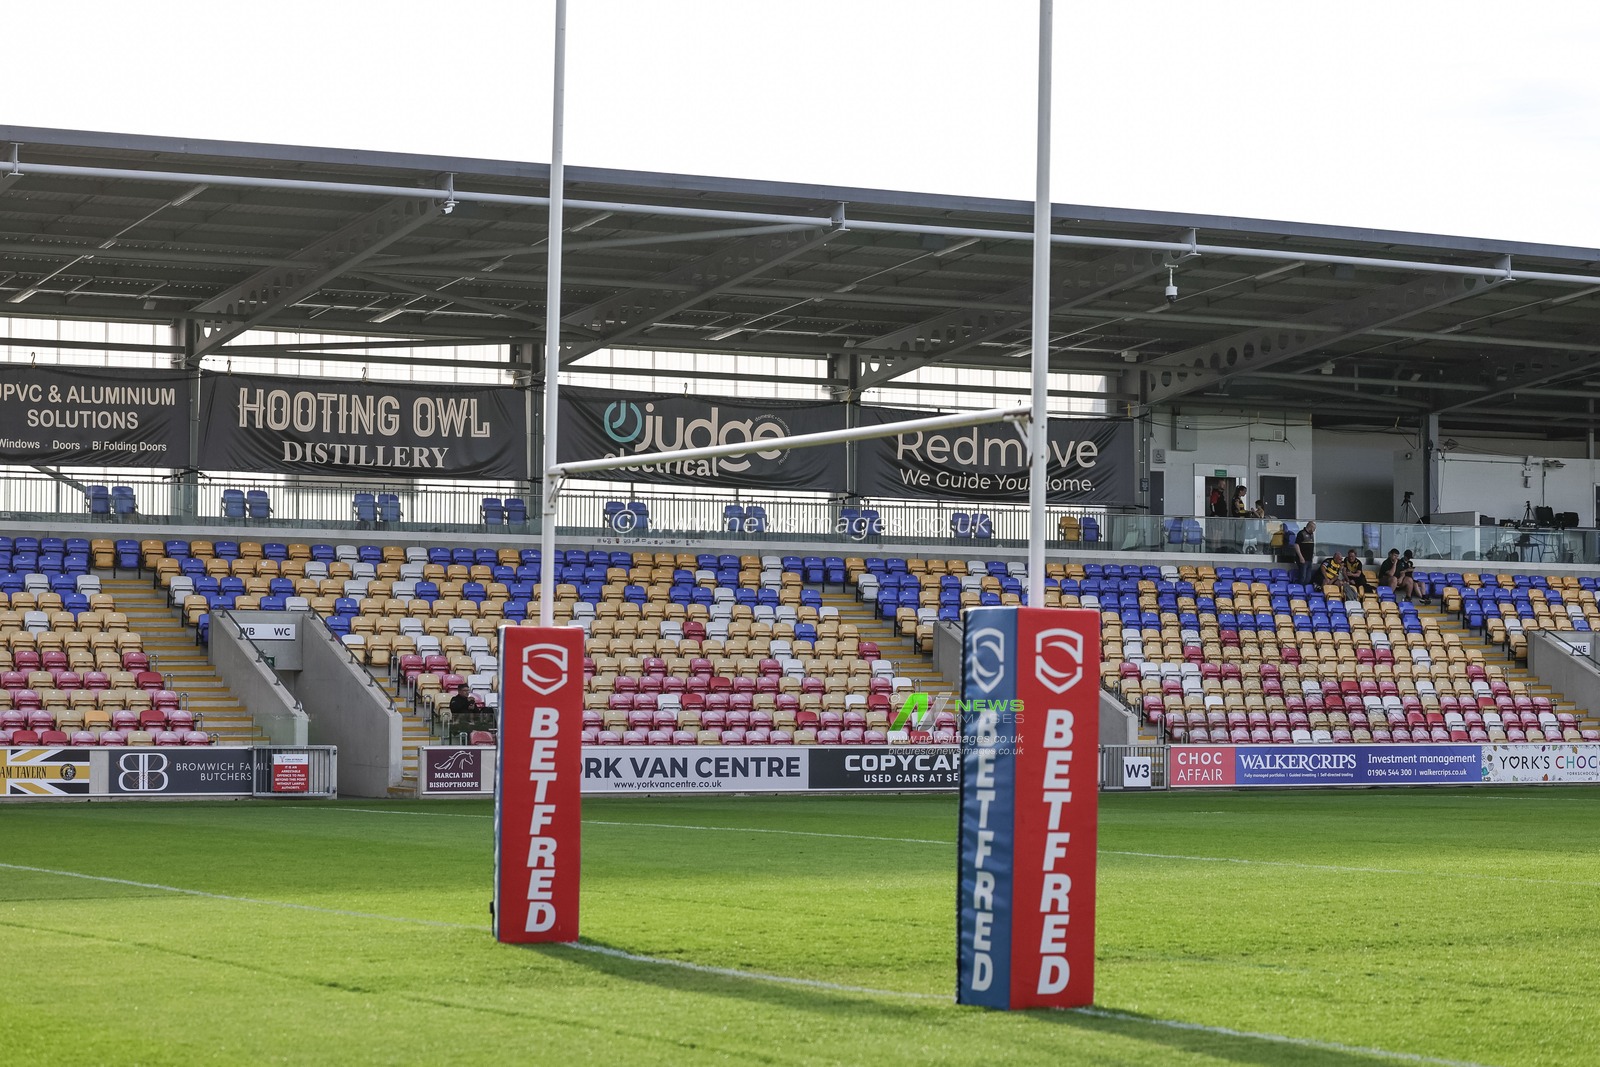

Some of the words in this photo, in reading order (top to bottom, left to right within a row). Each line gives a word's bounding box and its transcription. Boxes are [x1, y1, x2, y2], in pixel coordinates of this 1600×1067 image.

[0, 383, 42, 402] PVC
[48, 385, 61, 403] &
[67, 386, 175, 405] ALUMINIUM
[27, 409, 139, 430] SOLUTIONS
[238, 387, 400, 436] HOOTING
[412, 396, 491, 438] OWL
[634, 402, 786, 472] judge
[0, 438, 40, 449] Windows
[52, 440, 80, 450] Doors
[92, 440, 101, 450] Bi
[104, 441, 137, 453] Folding
[139, 442, 167, 451] Doors
[897, 427, 1098, 468] Redmve
[282, 440, 450, 468] DISTILLERY
[900, 468, 930, 487] We
[936, 471, 990, 489] Guide
[995, 474, 1032, 491] You
[274, 627, 290, 636] WC
[1177, 752, 1222, 765] CHOC
[1239, 753, 1357, 771] WALKERCRIPS
[1368, 753, 1417, 764] Investment
[1419, 754, 1476, 766] management
[1555, 755, 1600, 770] CHOC
[15, 766, 47, 780] TAVERN
[176, 762, 235, 771] BROMWICH
[580, 756, 622, 778] RK
[629, 757, 688, 778] VAN
[695, 756, 800, 778] CENTRE
[1125, 764, 1150, 778] W3
[1367, 768, 1386, 776] 01904
[1388, 768, 1399, 776] 544
[1401, 768, 1412, 776] 300
[1419, 768, 1467, 777] walkercrips.co.uk
[200, 772, 252, 781] BUTCHERS
[864, 774, 891, 783] USED
[896, 774, 924, 783] CARS
[929, 773, 942, 782] AT
[1177, 769, 1223, 781] AFFAIR
[613, 780, 722, 790] www.yorkvancentre.co.uk
[525, 707, 560, 933] BETFRED
[971, 708, 996, 993] BETFRED
[1036, 709, 1075, 995] BETFRED
